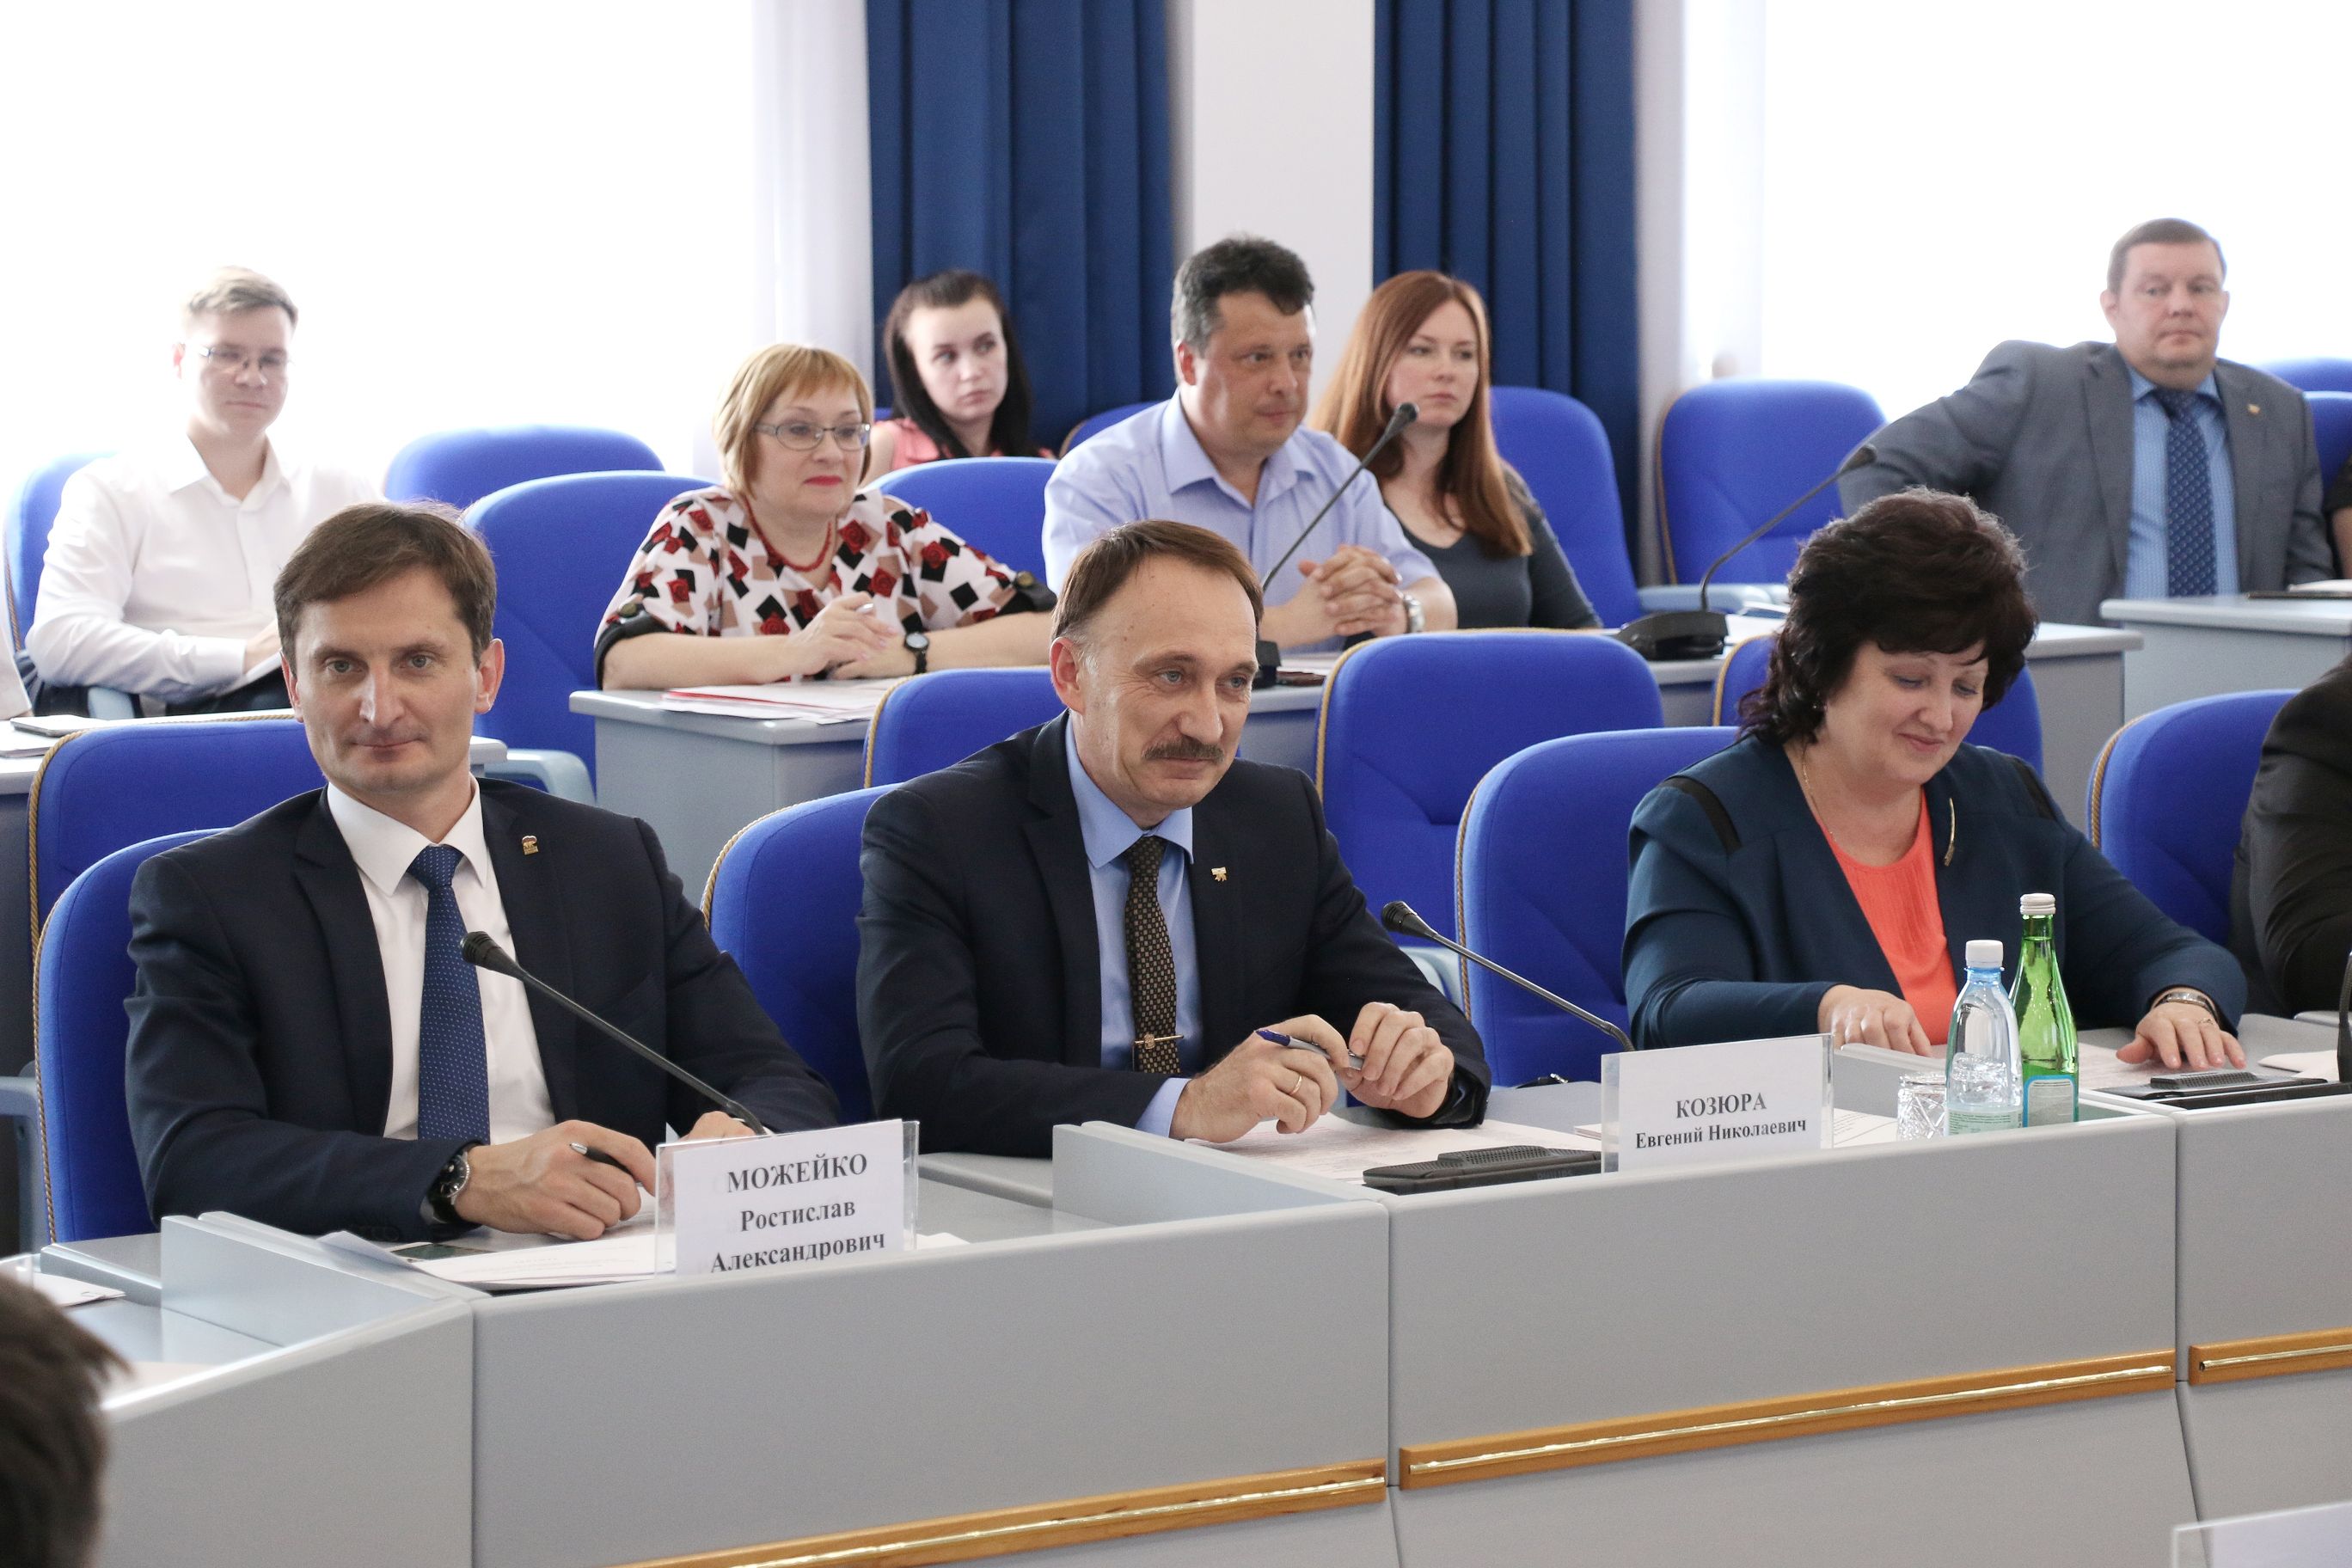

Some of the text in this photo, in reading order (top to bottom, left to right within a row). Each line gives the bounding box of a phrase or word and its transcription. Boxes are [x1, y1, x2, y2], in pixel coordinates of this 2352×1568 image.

[1676, 1093, 1767, 1118] КОЗЮРА
[1636, 1119, 1807, 1148] Евгений Николаевич
[727, 1153, 867, 1193] МОЖЕЙКО
[740, 1202, 856, 1232] Ростислав
[711, 1233, 885, 1273] Александрович
